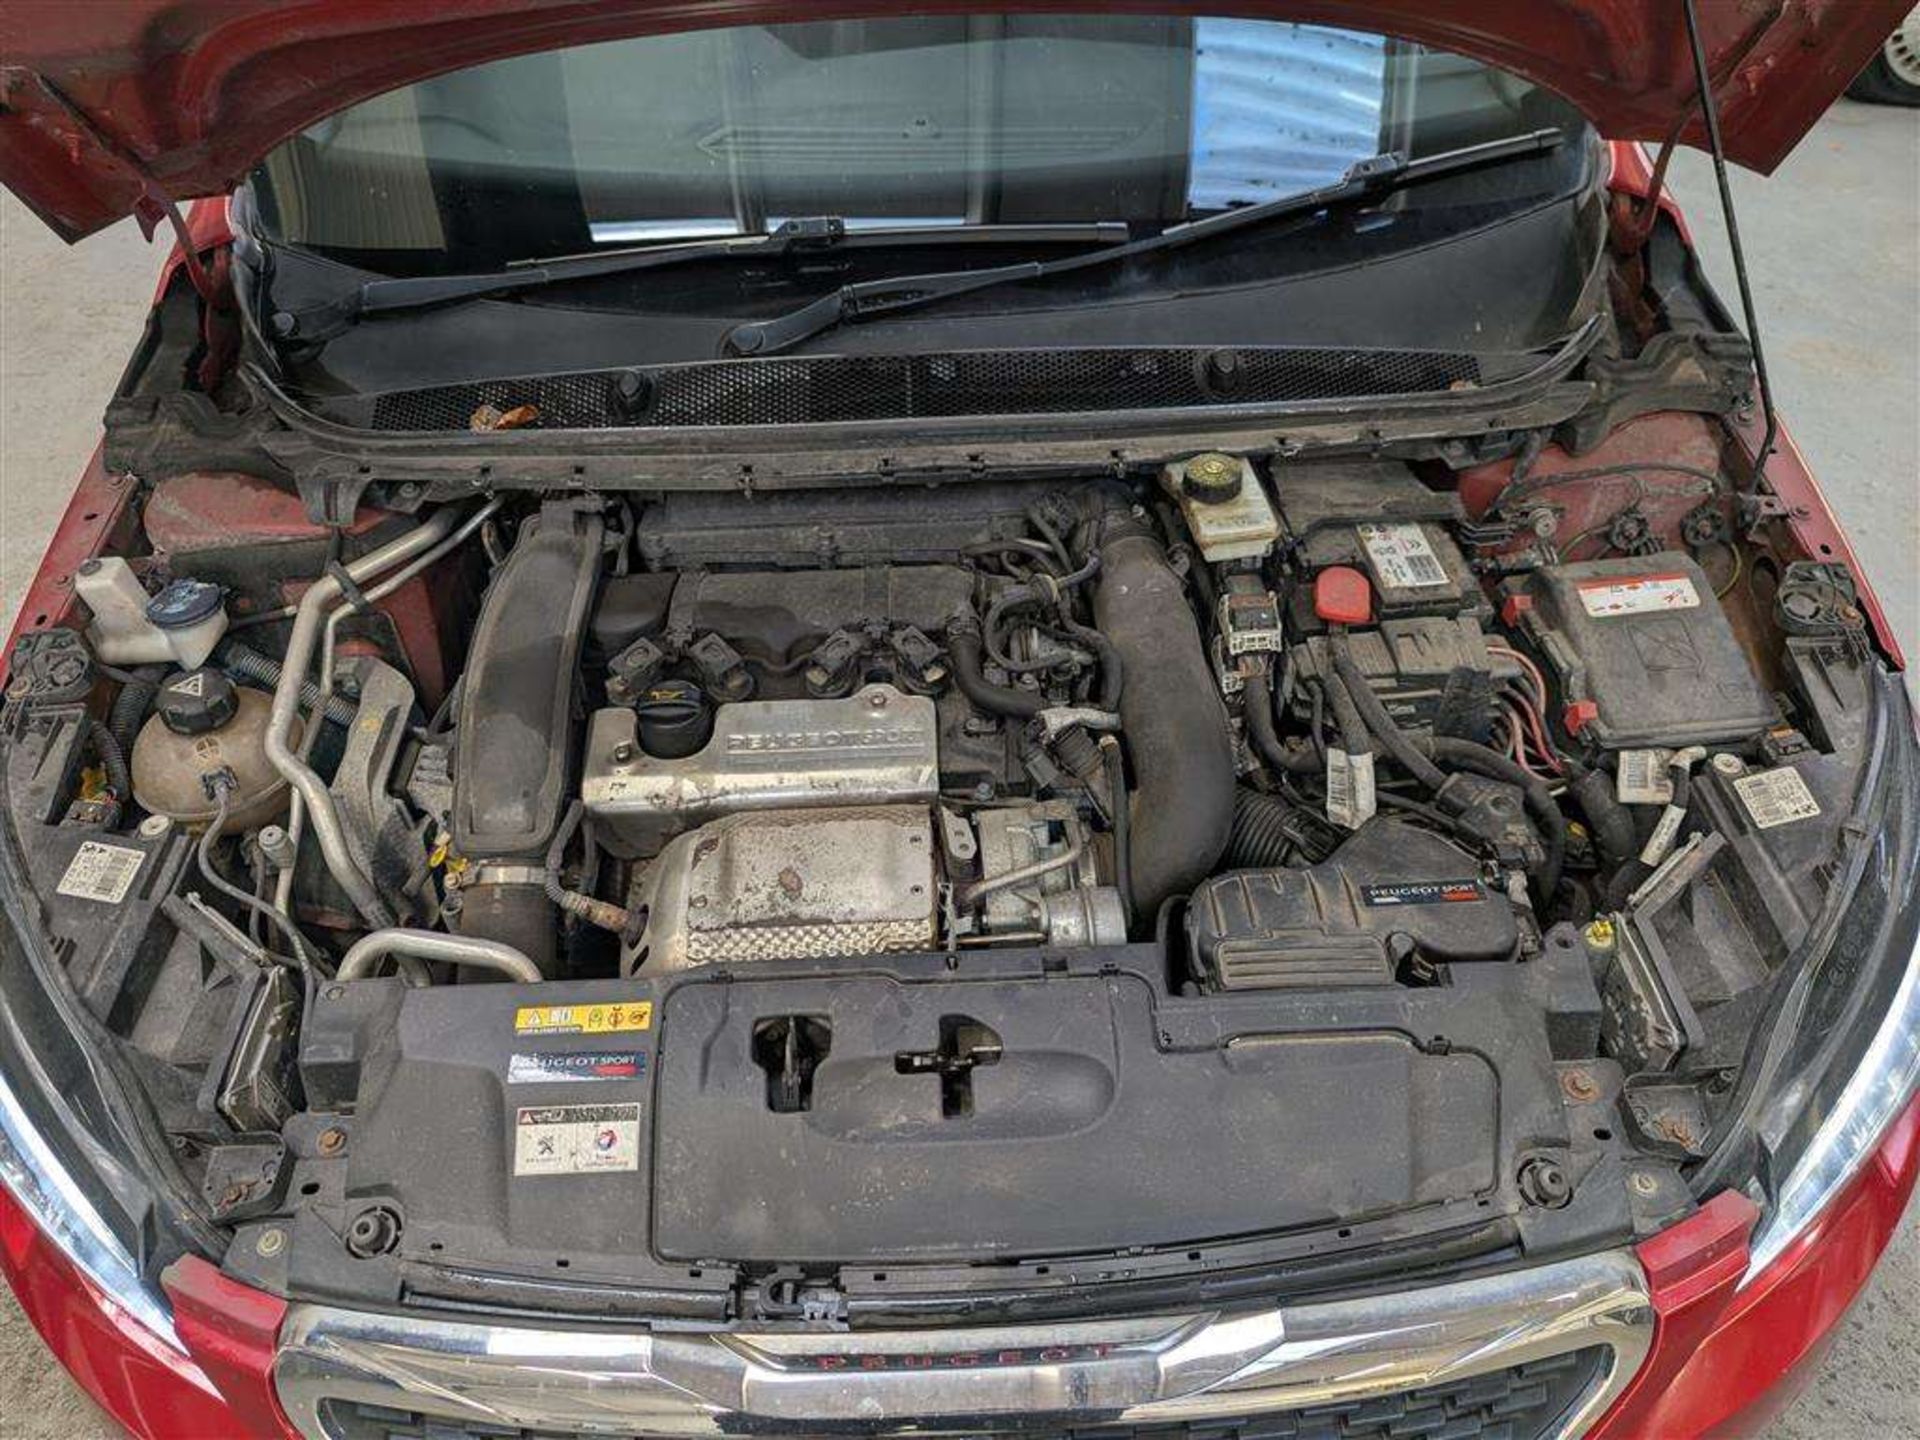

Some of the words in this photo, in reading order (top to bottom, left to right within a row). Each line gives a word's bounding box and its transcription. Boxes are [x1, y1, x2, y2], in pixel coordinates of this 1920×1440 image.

[1369, 885, 1439, 898] PEUGEOT
[600, 1055, 636, 1066] SPORT
[817, 1343, 1111, 1371] PEUGEOT
